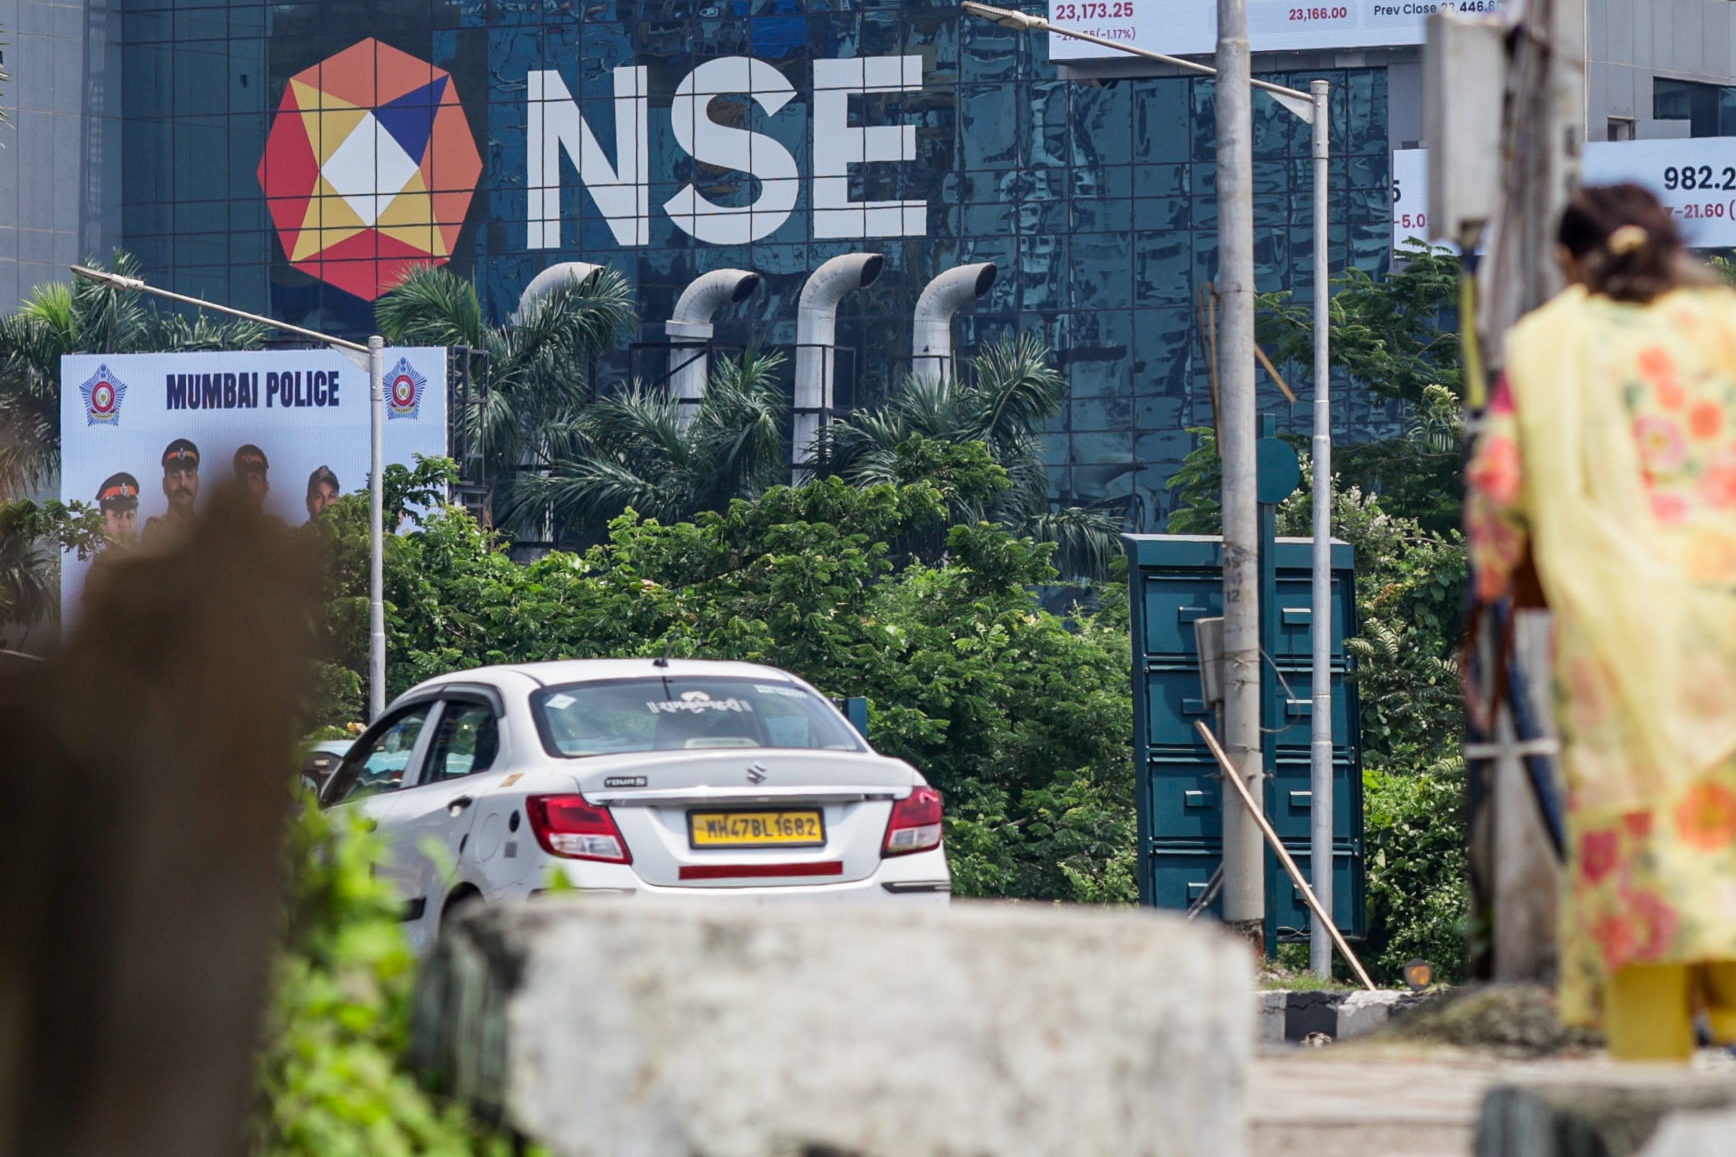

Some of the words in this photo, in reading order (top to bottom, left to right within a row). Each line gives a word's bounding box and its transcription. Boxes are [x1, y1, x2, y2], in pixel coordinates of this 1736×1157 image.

[1056, 2, 1134, 21] 23,173.25
[1289, 7, 1347, 22] 23,166.00
[1374, 5, 1401, 15] Prev
[1403, 3, 1437, 15] Close
[527, 54, 927, 250] NSE
[1675, 203, 1725, 219] -21.60
[166, 372, 259, 410] MUMBAI
[266, 370, 340, 408] POLICE
